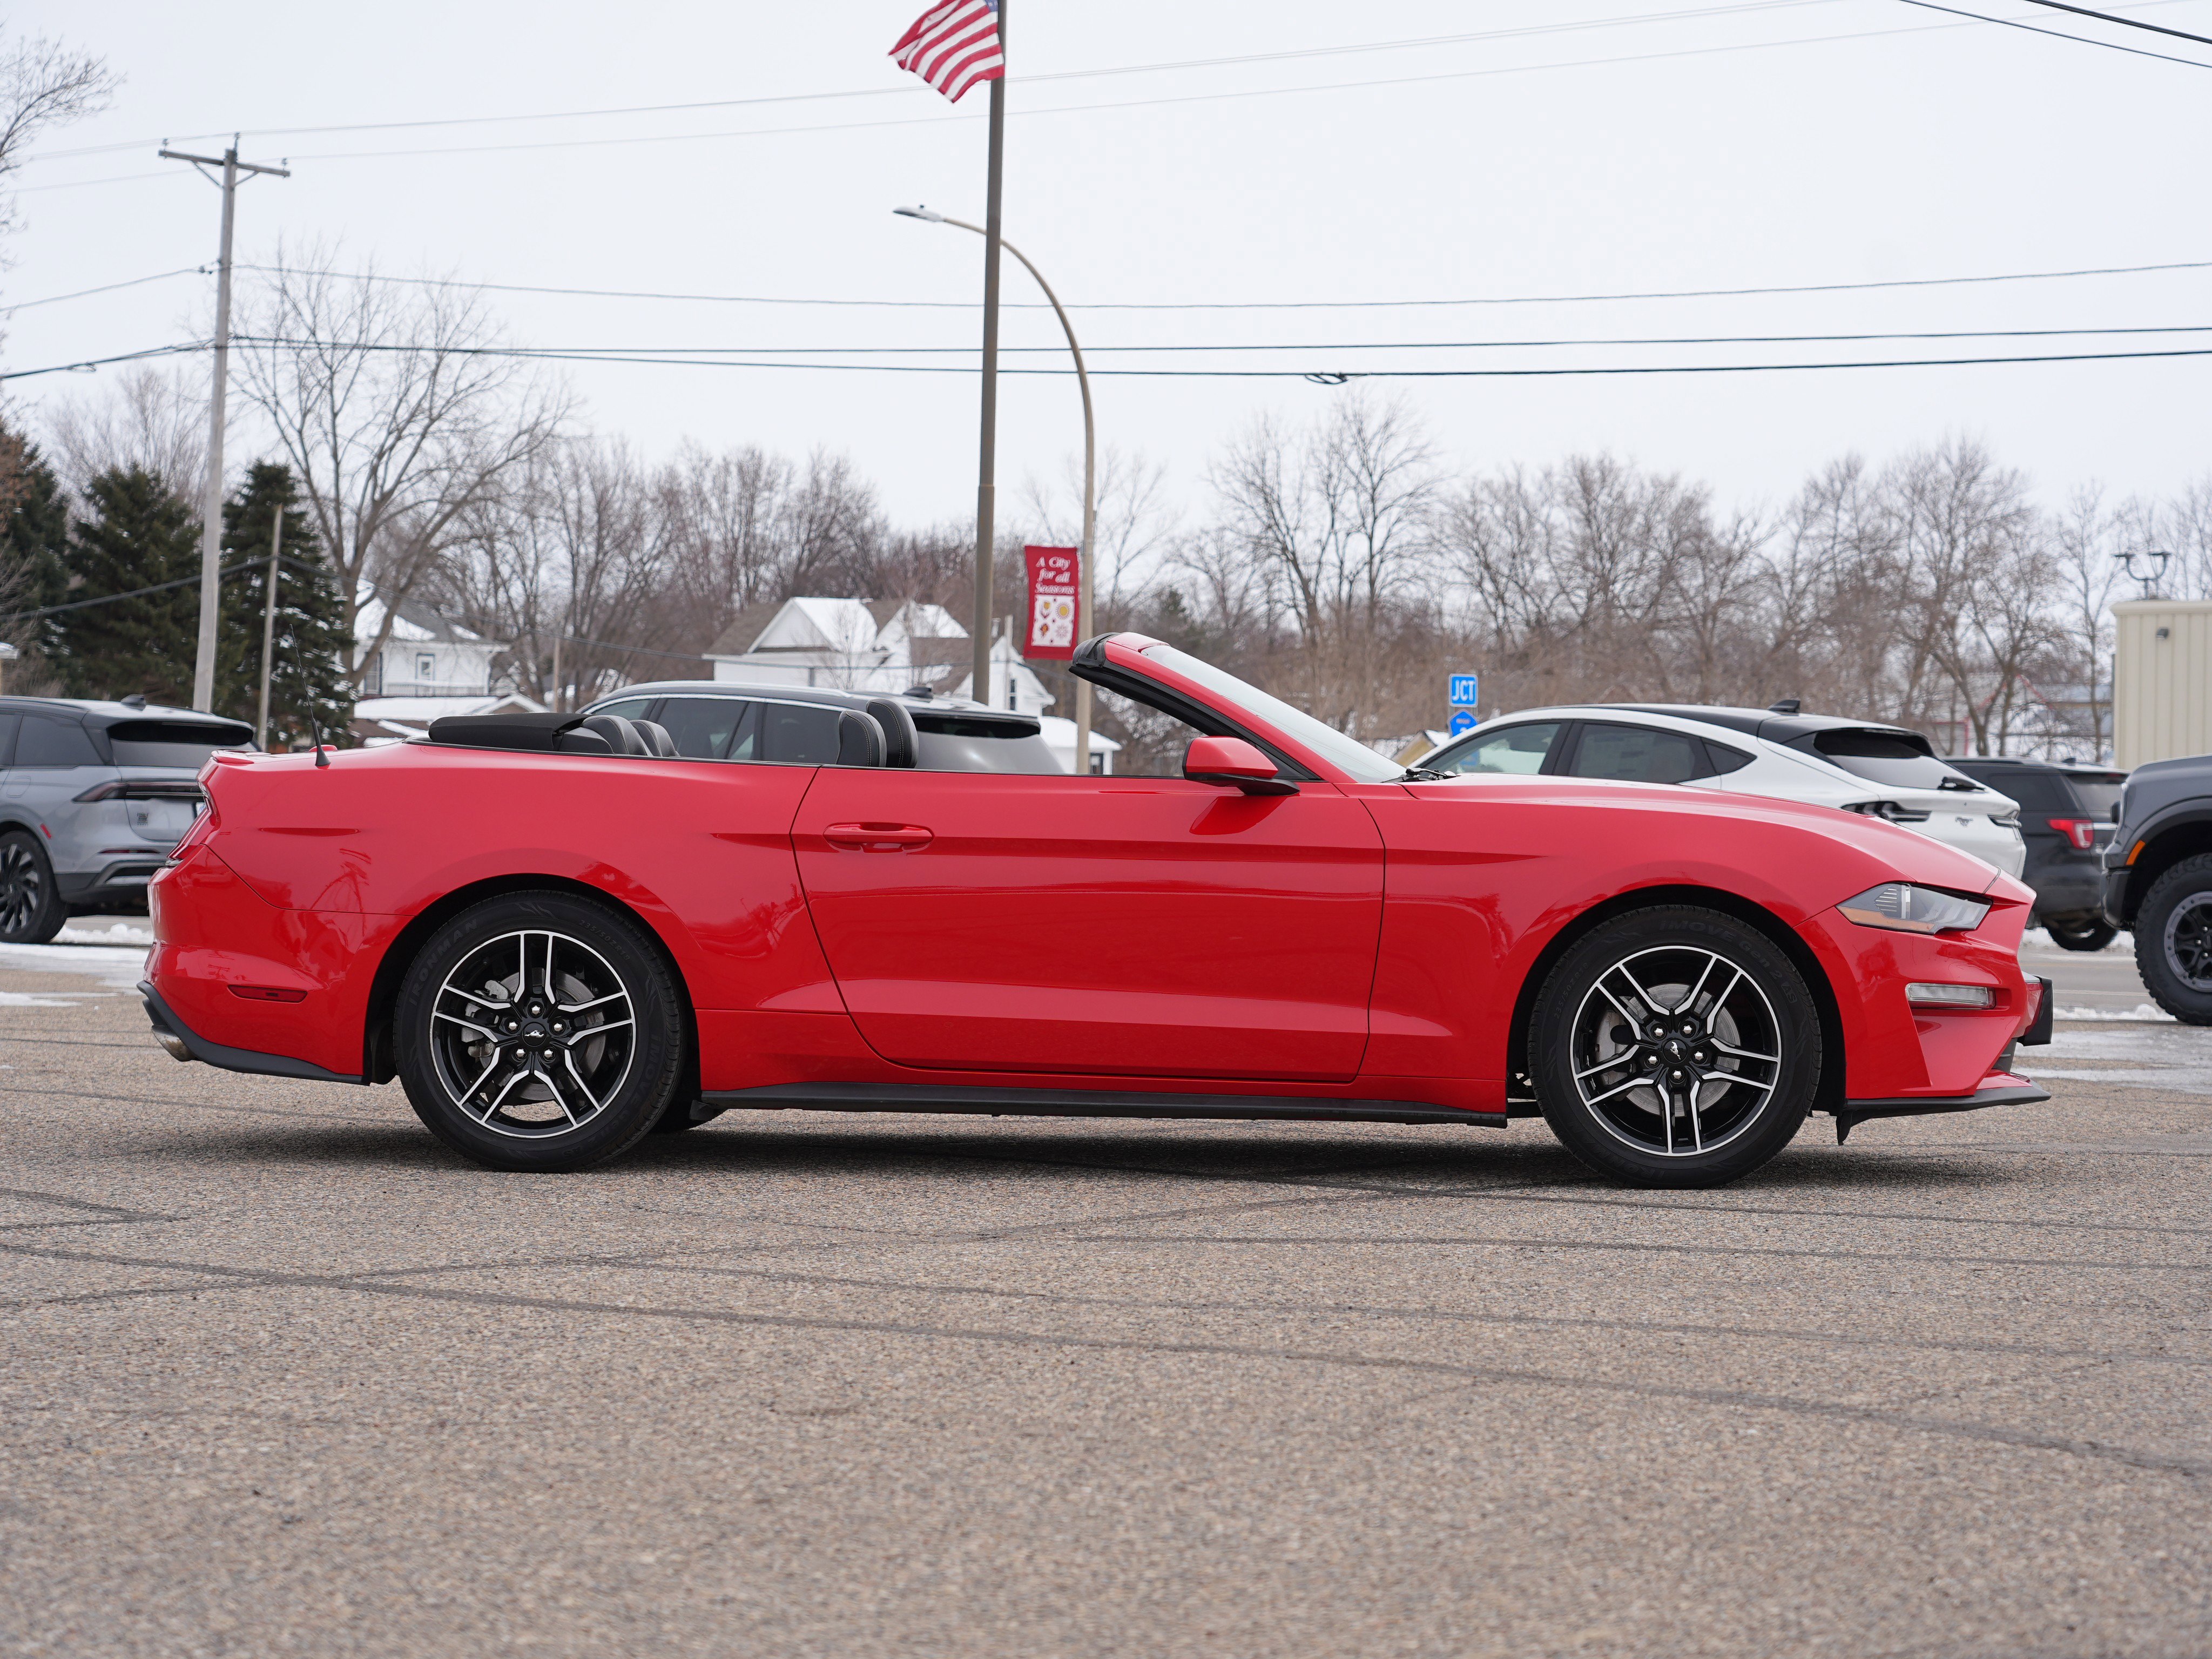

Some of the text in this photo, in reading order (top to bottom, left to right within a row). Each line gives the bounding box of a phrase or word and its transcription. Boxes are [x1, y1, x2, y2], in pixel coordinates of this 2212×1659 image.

[1036, 557, 1071, 570] A City
[1037, 568, 1071, 583] for all
[1035, 583, 1075, 595] Seasons
[1452, 679, 1474, 702] JCT
[408, 919, 477, 1006] IRONMAN
[1739, 941, 1770, 968] Gen
[1781, 980, 1798, 1003] AS
